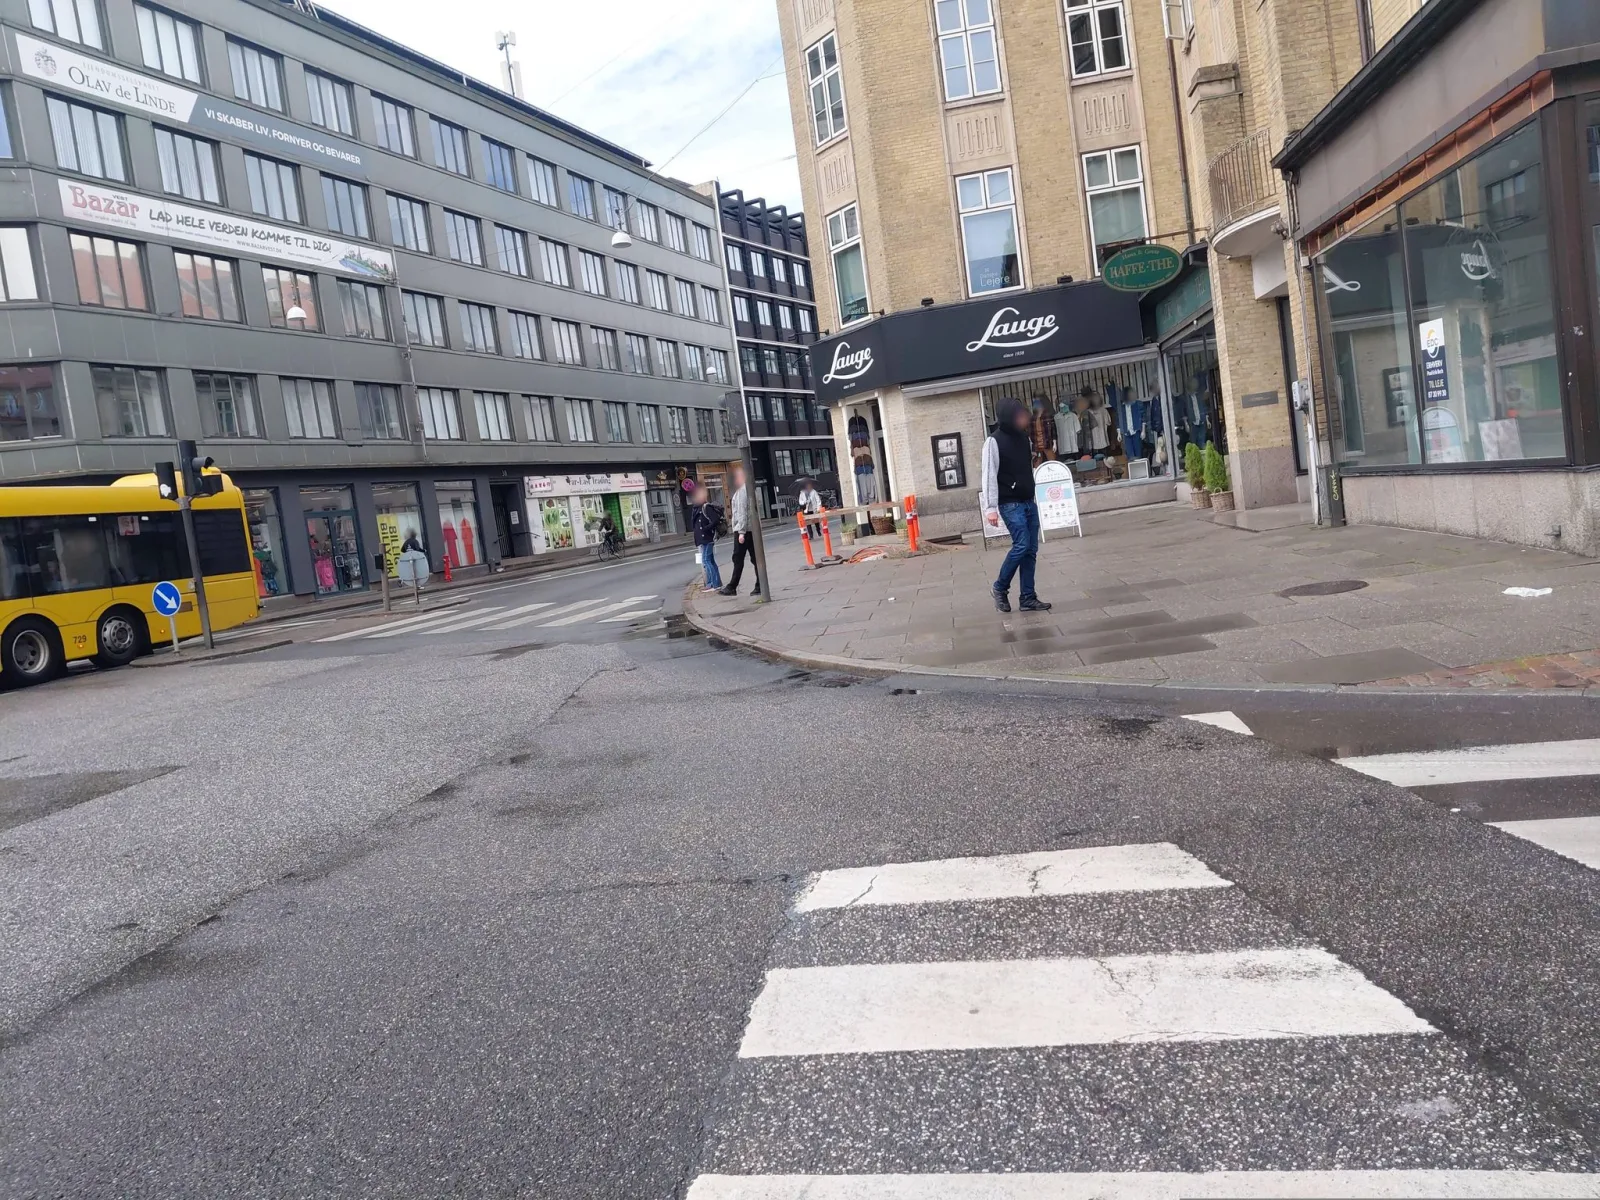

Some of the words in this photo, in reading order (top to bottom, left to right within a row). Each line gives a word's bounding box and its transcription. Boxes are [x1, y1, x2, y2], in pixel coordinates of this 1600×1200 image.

[68, 66, 112, 93] OLAV
[115, 85, 131, 100] de
[134, 87, 177, 114] LINDE
[204, 108, 215, 120] VI
[216, 112, 254, 132] SKABER
[255, 123, 272, 138] LIV,
[272, 129, 312, 150] FORNYER
[312, 142, 325, 154] OG
[325, 146, 361, 165] BEVARER
[67, 184, 140, 219] Bazar
[112, 194, 128, 202] VEST
[149, 209, 173, 223] LAD
[176, 214, 206, 229] HELE
[208, 219, 248, 237] VERDEN
[251, 228, 291, 246] KOMME
[293, 236, 311, 249] TIL
[966, 307, 1060, 352] Lauge
[1426, 338, 1439, 347] EDC
[822, 341, 874, 385] Lauge
[73, 634, 87, 644] 729
